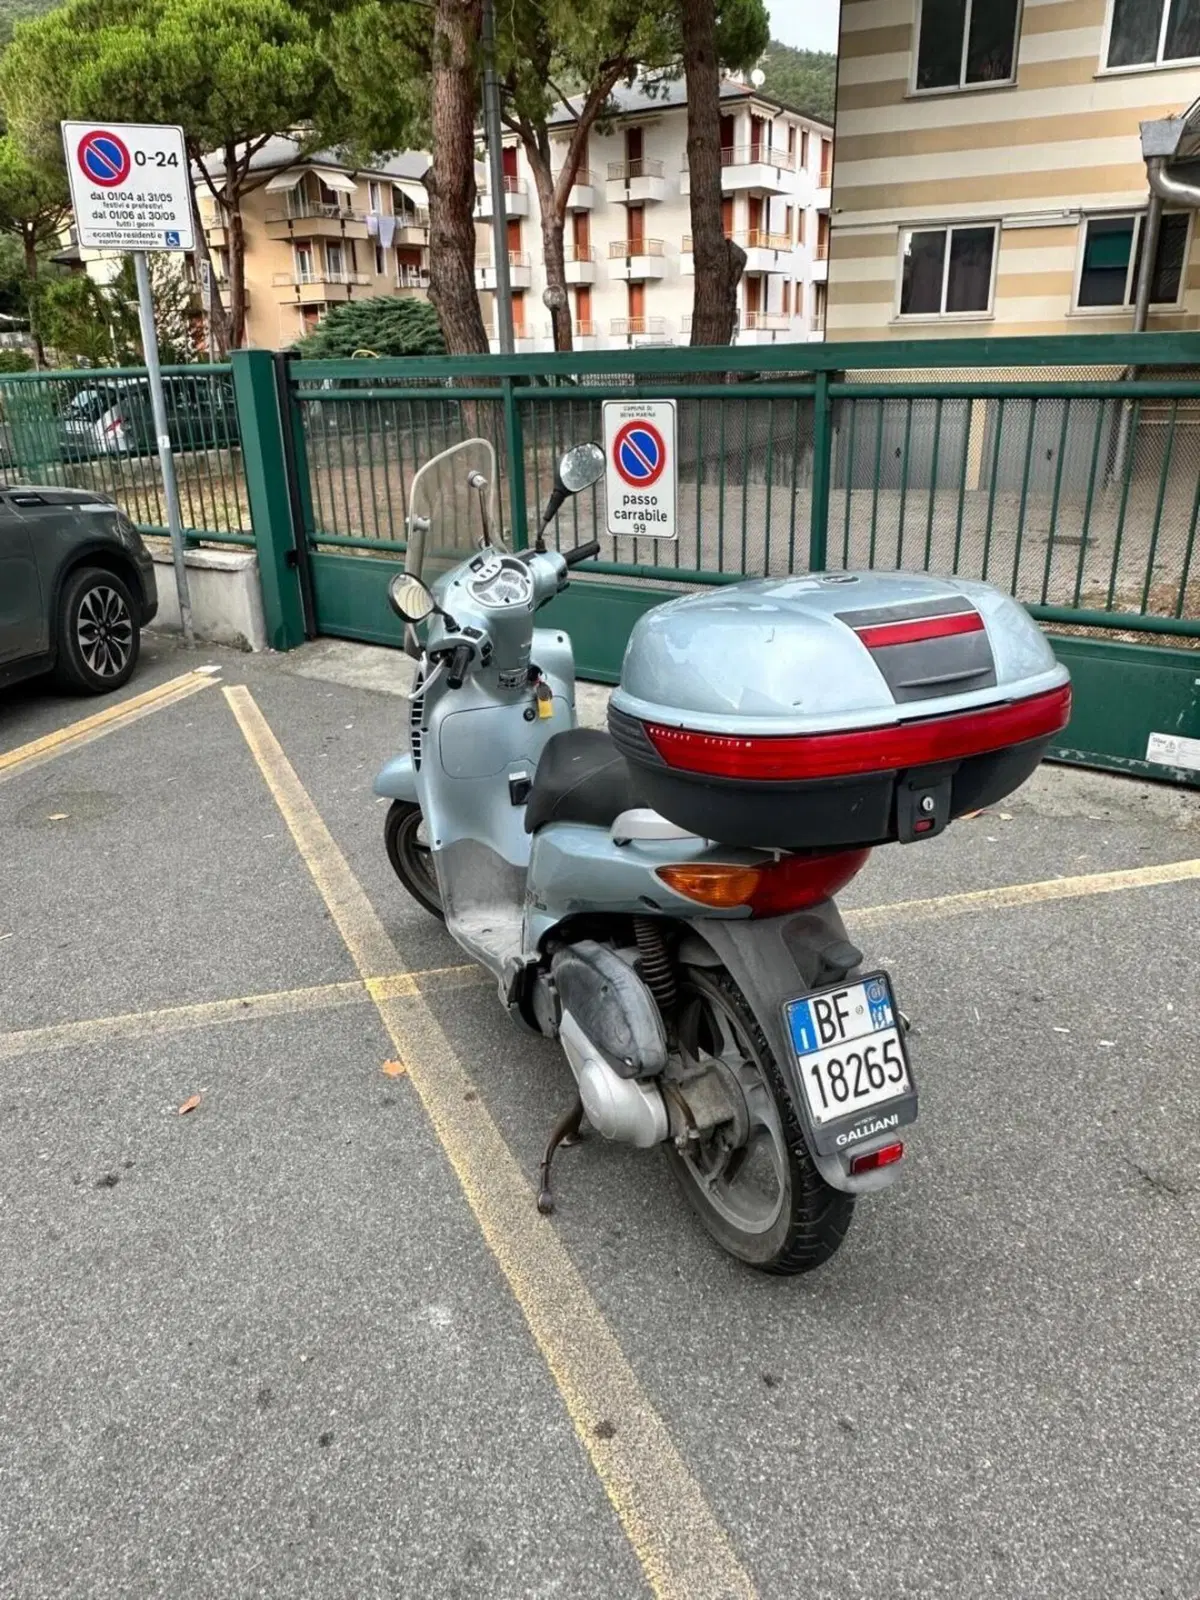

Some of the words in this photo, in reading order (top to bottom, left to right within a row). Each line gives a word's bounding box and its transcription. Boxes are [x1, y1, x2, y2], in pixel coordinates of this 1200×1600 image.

[134, 150, 179, 168] 0-24
[90, 191, 105, 201] dal
[107, 191, 134, 201] 01/04
[136, 192, 146, 202] al
[147, 192, 173, 202] 31/05
[102, 201, 125, 209] festivi
[92, 210, 107, 219] dal
[109, 210, 135, 220] 01/06
[137, 211, 146, 220] al
[148, 211, 176, 221] 30/09
[123, 231, 156, 239] residenti
[622, 494, 658, 506] passo
[613, 508, 668, 522] carrabile
[633, 523, 647, 534] 99
[813, 991, 849, 1044] BF
[811, 1038, 903, 1109] 18265
[836, 1113, 899, 1146] GALLIANI
